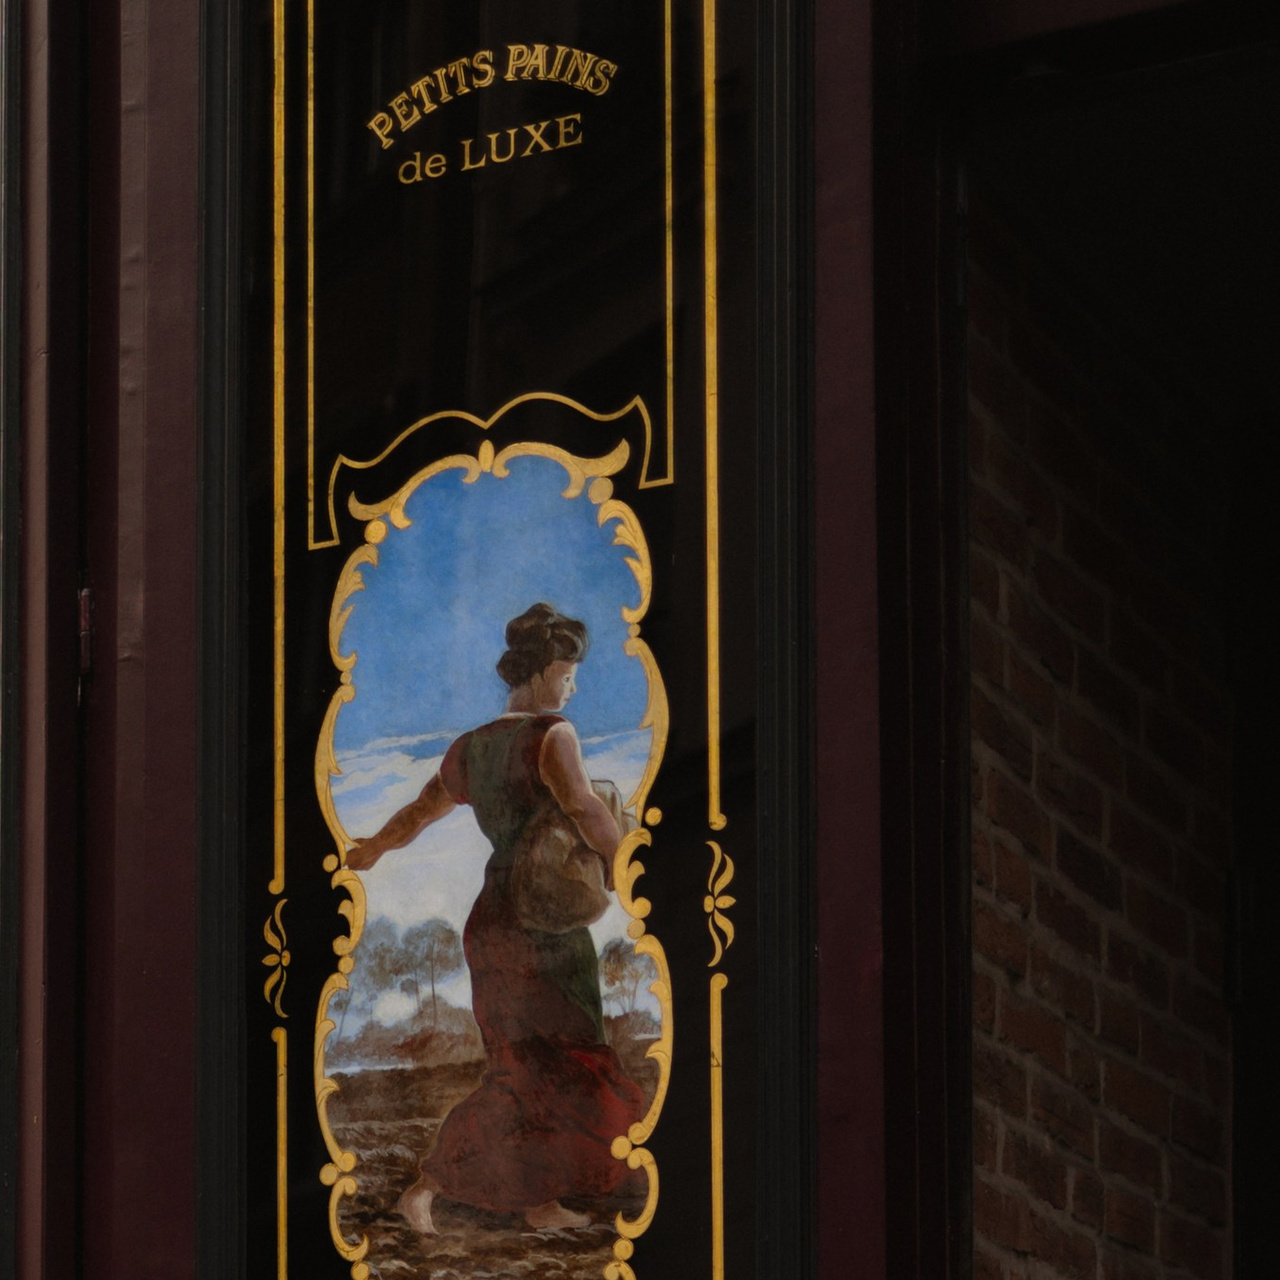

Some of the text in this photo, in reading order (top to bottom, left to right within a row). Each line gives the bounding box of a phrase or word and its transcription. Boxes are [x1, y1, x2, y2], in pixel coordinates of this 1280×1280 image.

[367, 43, 618, 149] PETITS PAINS
[398, 112, 583, 185] de LUXE
